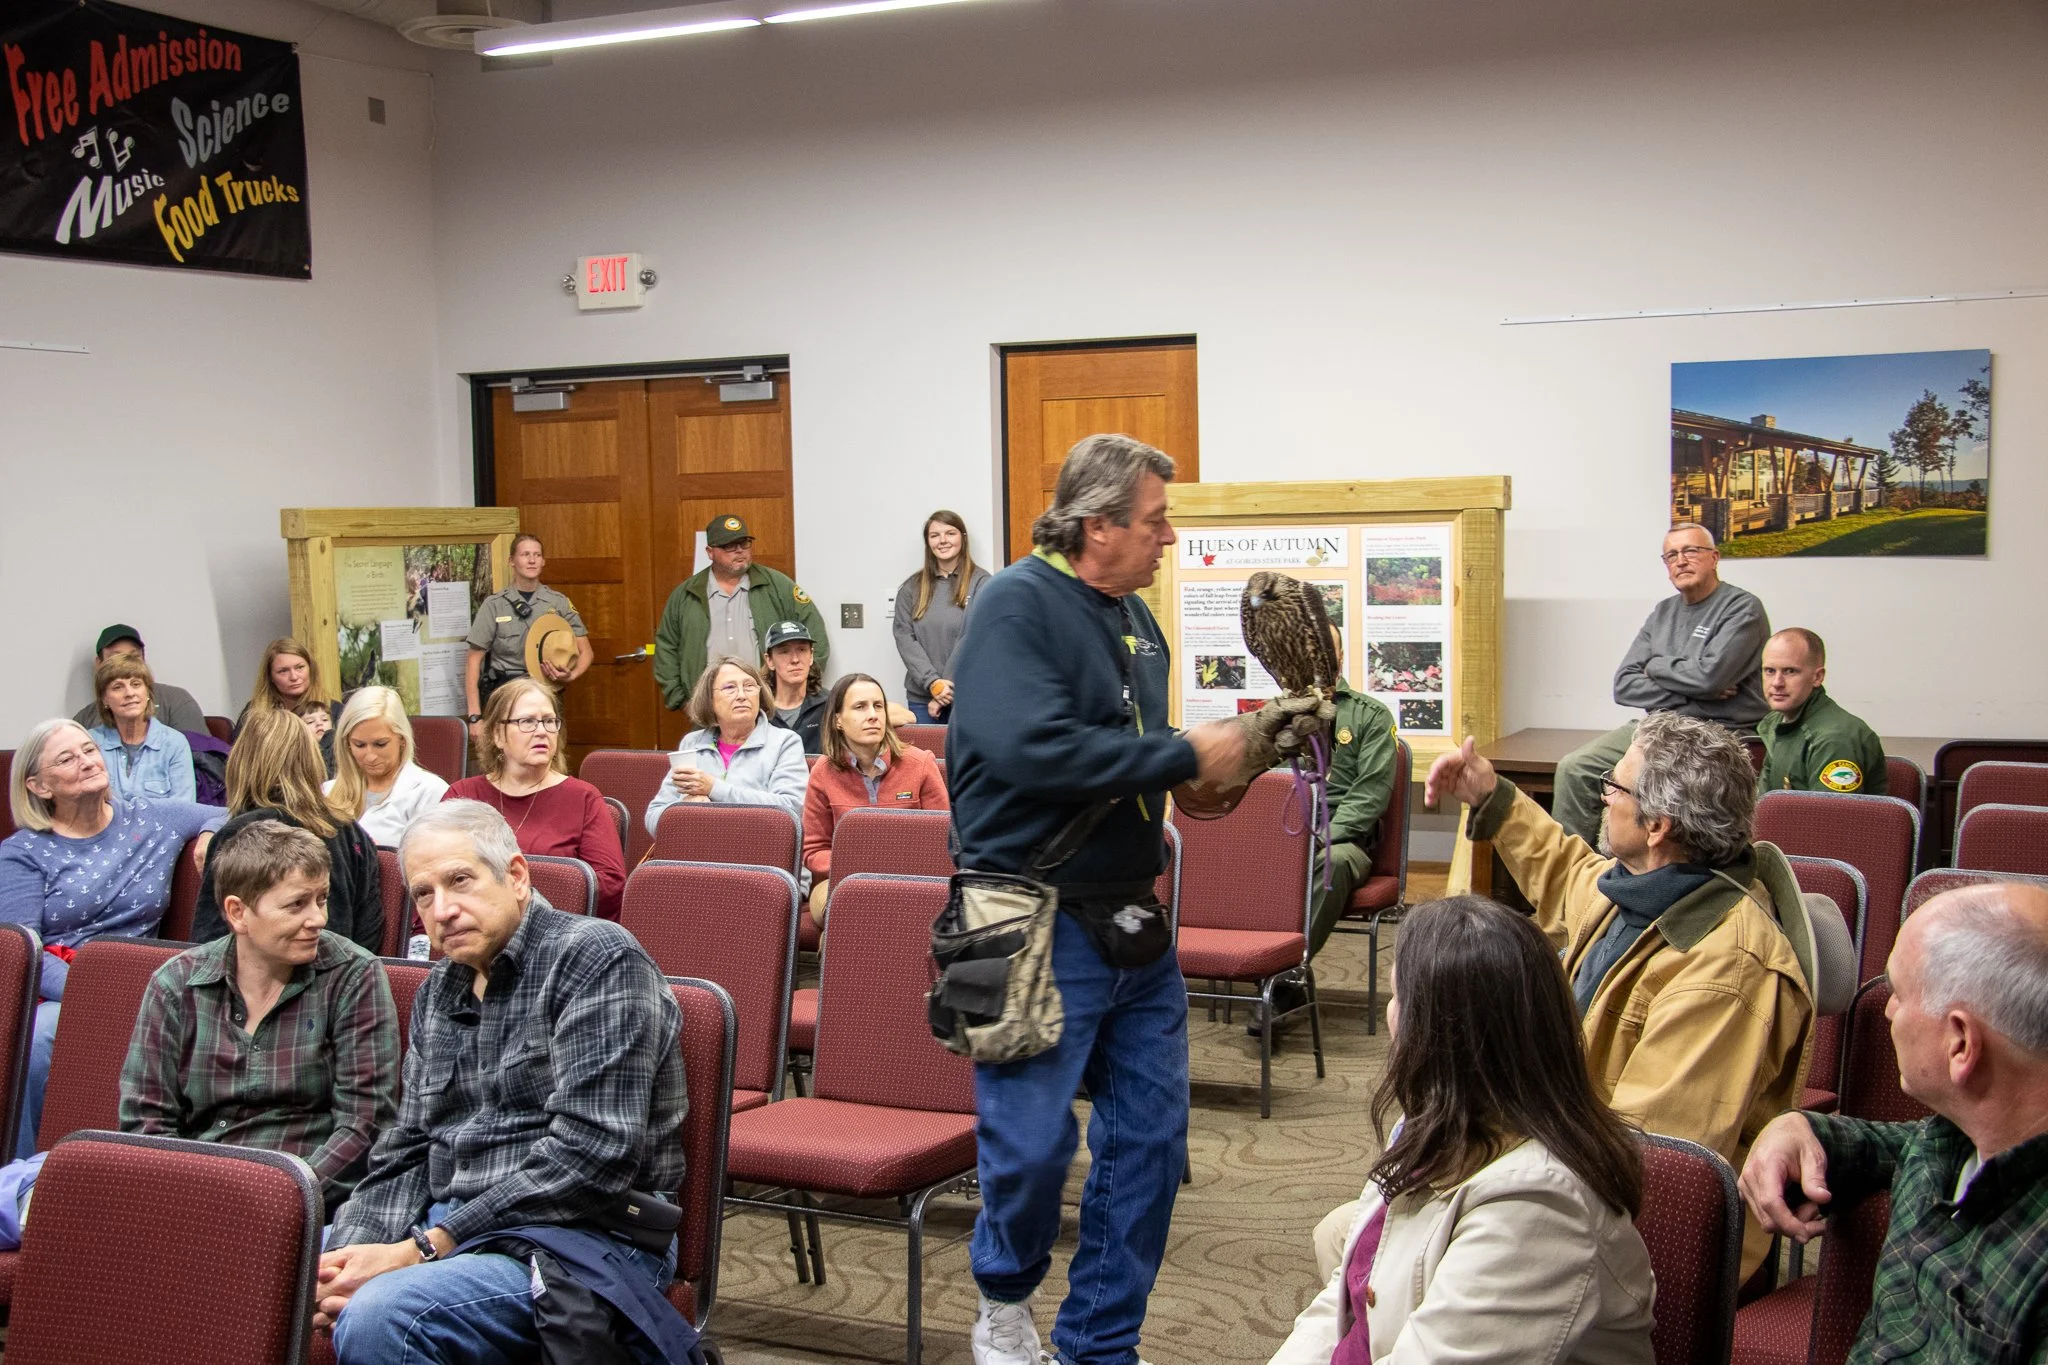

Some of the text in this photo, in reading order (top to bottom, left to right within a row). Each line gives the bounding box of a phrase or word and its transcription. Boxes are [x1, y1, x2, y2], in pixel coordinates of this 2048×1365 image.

[4, 29, 242, 146] Free Admission
[171, 93, 290, 169] Science
[55, 168, 166, 244] Music
[153, 170, 300, 263] Food Trucks
[586, 257, 628, 293] EXIT
[1187, 537, 1341, 556] HUES OF AUTUMN
